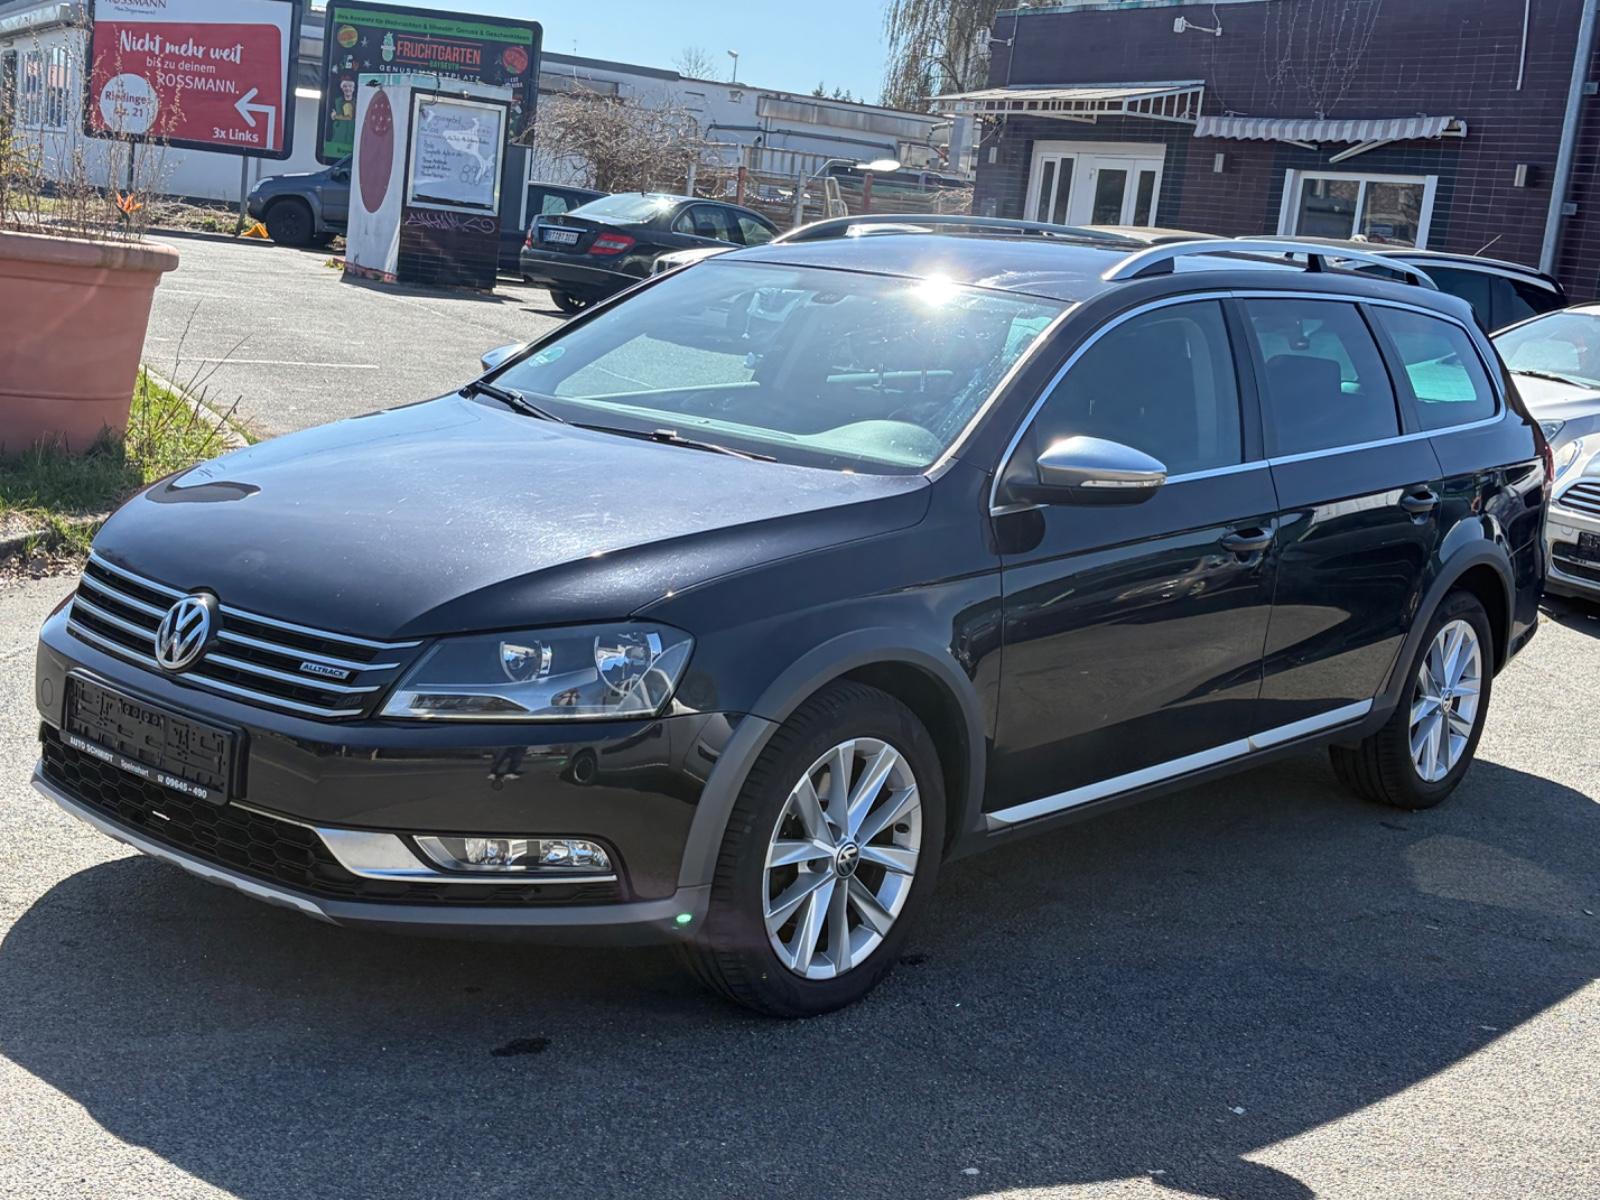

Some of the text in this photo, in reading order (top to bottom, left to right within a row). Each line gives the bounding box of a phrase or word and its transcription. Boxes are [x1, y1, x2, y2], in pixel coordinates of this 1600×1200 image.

[120, 29, 244, 65] Nicht mehr weit
[396, 41, 482, 65] FRUCHTGARTEN
[146, 56, 216, 74] bis zu deinem
[132, 107, 144, 117] 21
[212, 127, 259, 143] 3x Links
[303, 663, 346, 678] ALLTRACK
[69, 736, 86, 751] AUTO
